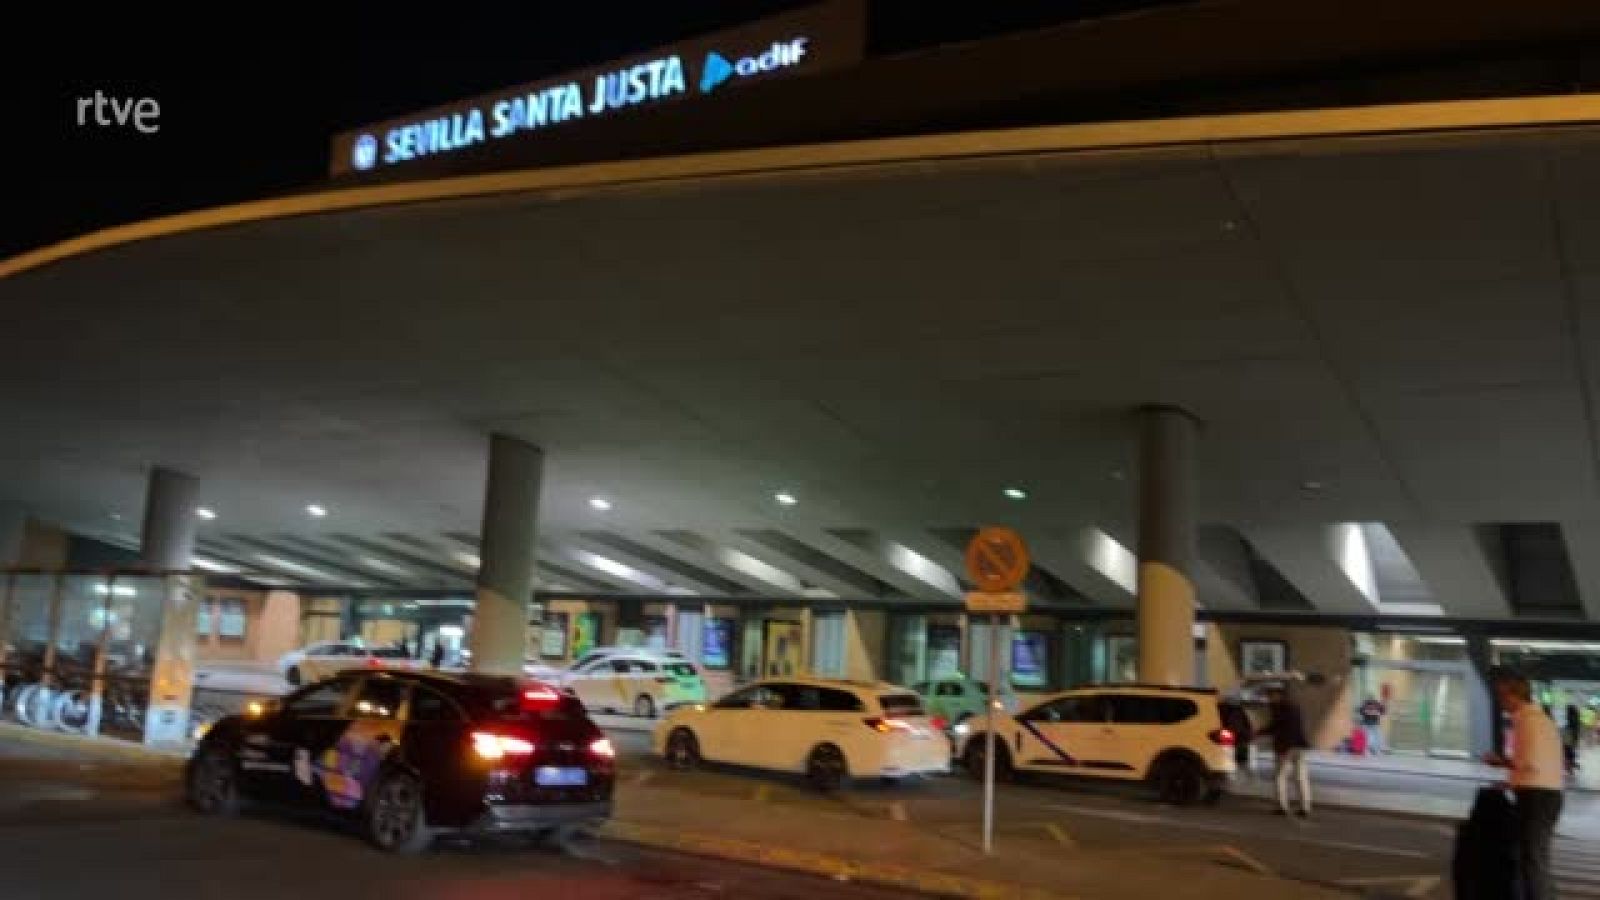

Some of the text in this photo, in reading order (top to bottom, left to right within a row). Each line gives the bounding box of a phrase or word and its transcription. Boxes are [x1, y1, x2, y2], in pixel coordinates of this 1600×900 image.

[735, 38, 808, 75] adif
[384, 55, 685, 165] SEVILLA SANTA JUSTA
